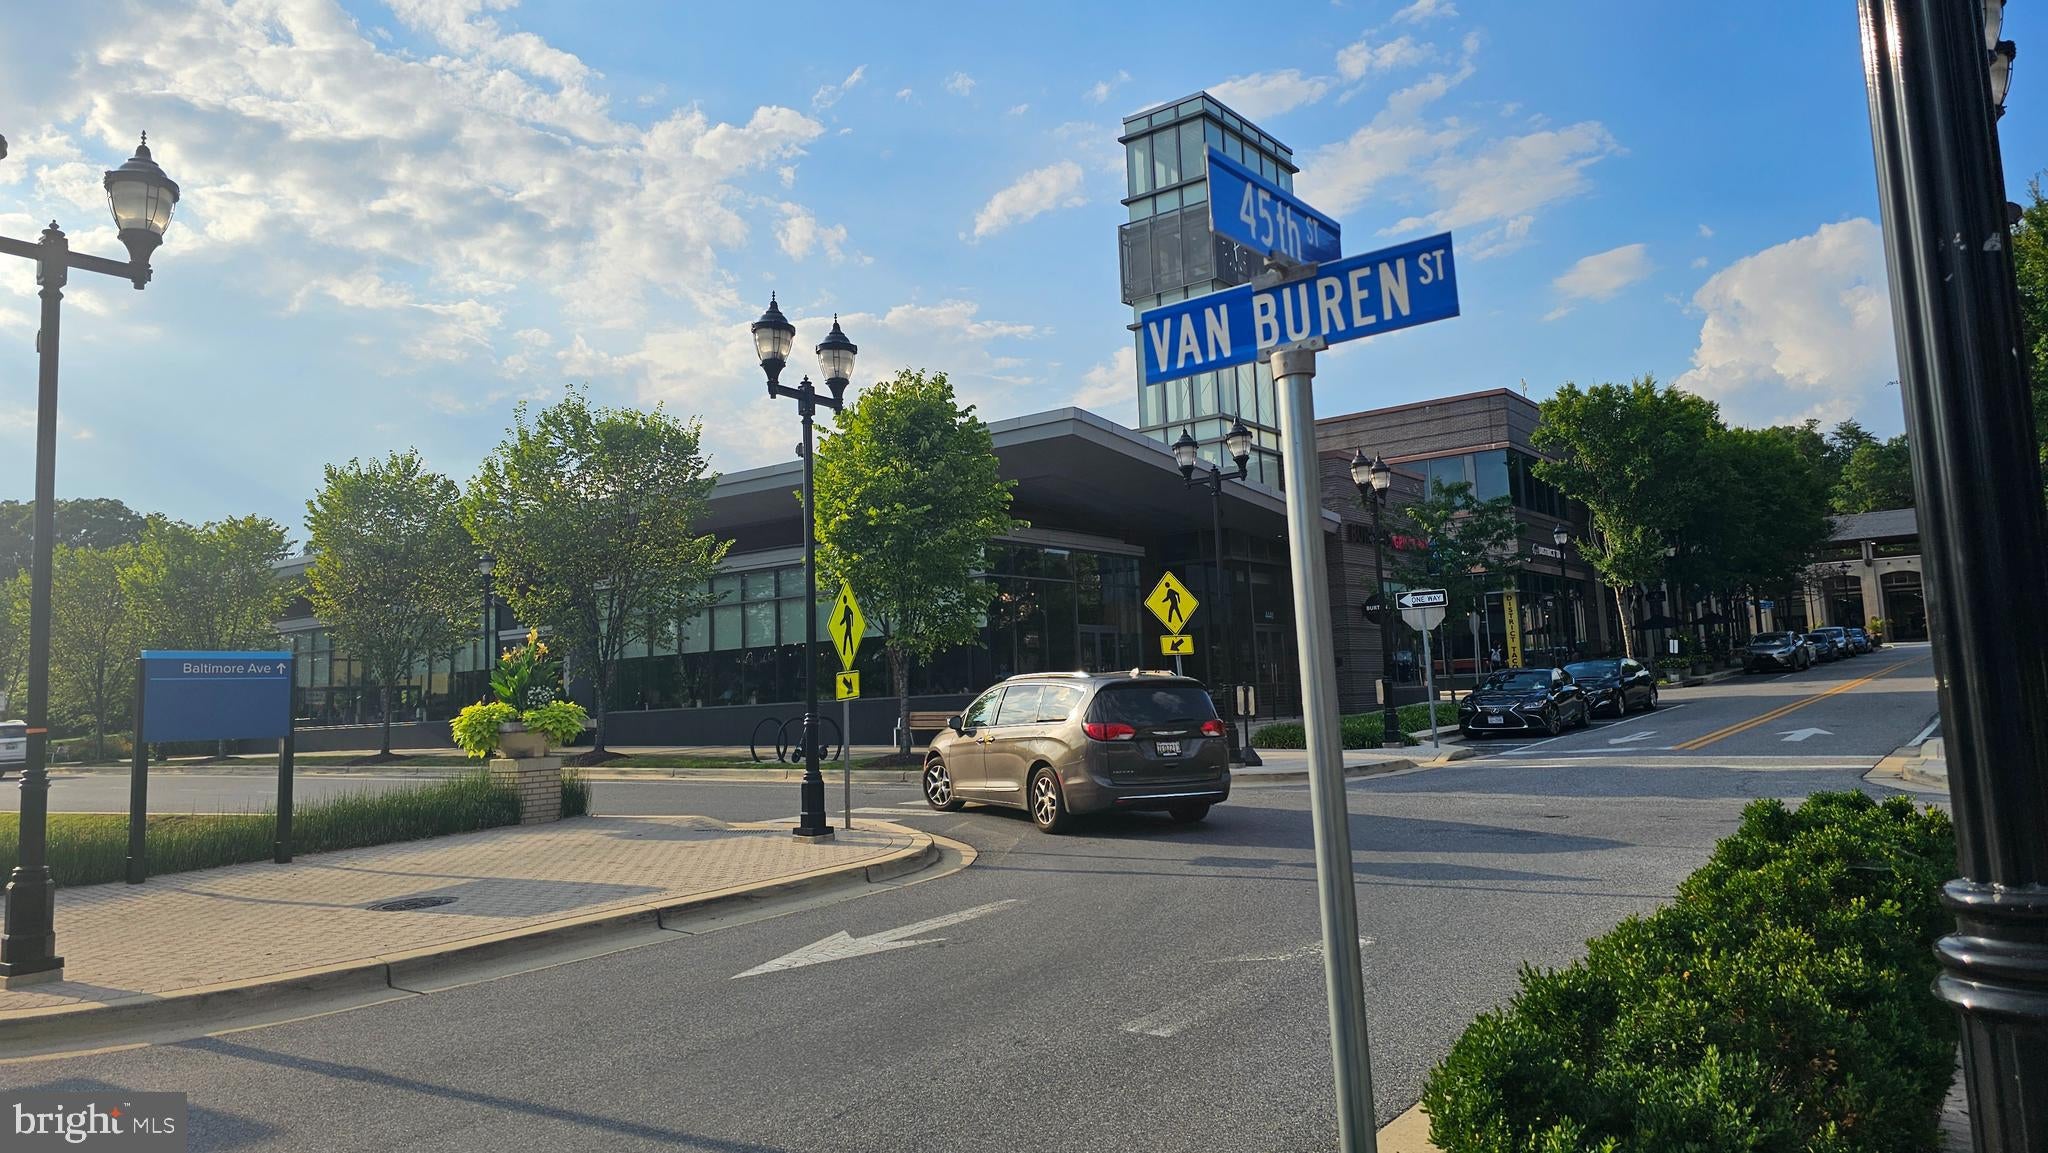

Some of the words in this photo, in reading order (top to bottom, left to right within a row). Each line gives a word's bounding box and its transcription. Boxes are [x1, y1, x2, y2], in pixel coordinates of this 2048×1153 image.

[1239, 182, 1302, 262] 45th
[1305, 216, 1320, 247] ST
[1149, 303, 1232, 373] VAN
[1253, 258, 1410, 350] BUREN
[1418, 249, 1446, 285] ST
[1411, 596, 1424, 604] ONE
[1427, 594, 1441, 602] WAY
[1506, 595, 1515, 643] DISTRICT
[183, 663, 244, 674] Baltimore
[247, 663, 271, 674] Ave
